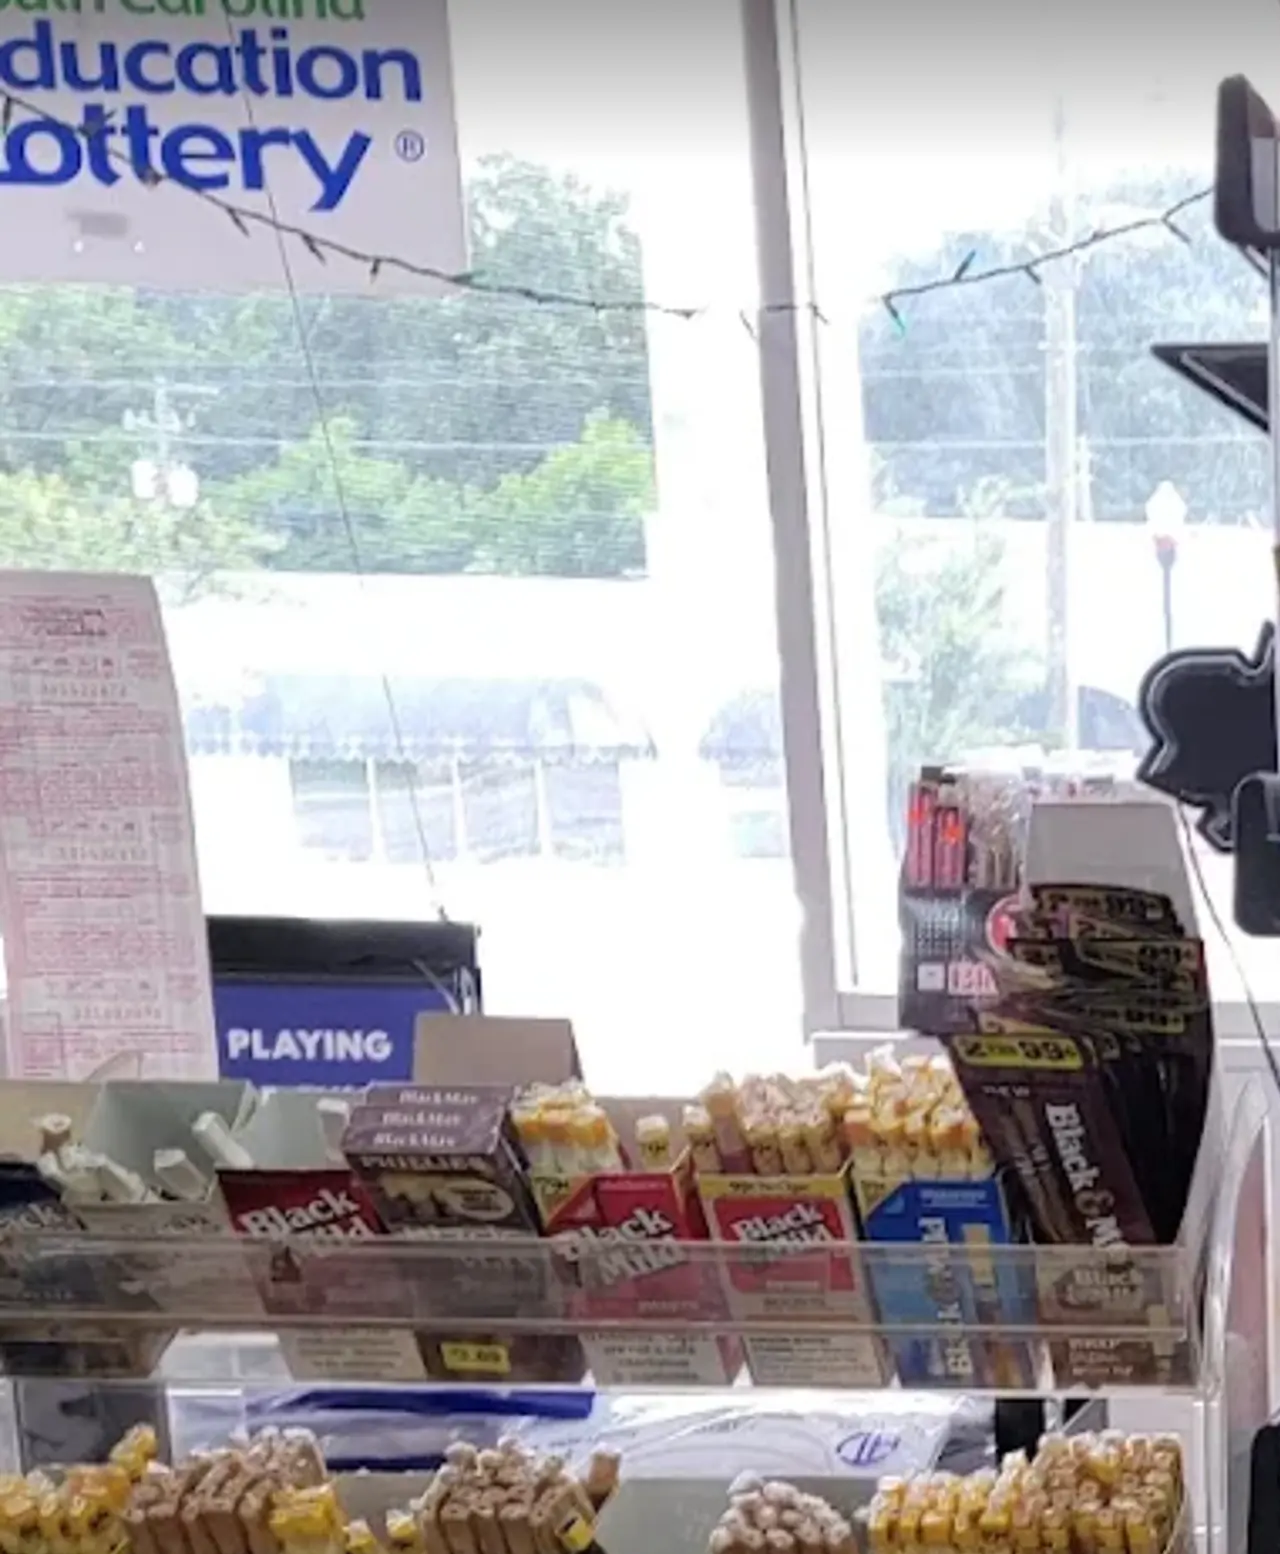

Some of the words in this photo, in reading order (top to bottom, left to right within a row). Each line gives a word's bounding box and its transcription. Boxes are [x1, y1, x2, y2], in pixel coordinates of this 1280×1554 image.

[226, 1028, 394, 1062] PLAYING
[1045, 1104, 1087, 1192] Black
[242, 1188, 362, 1235] Black
[730, 1203, 822, 1243] Black
